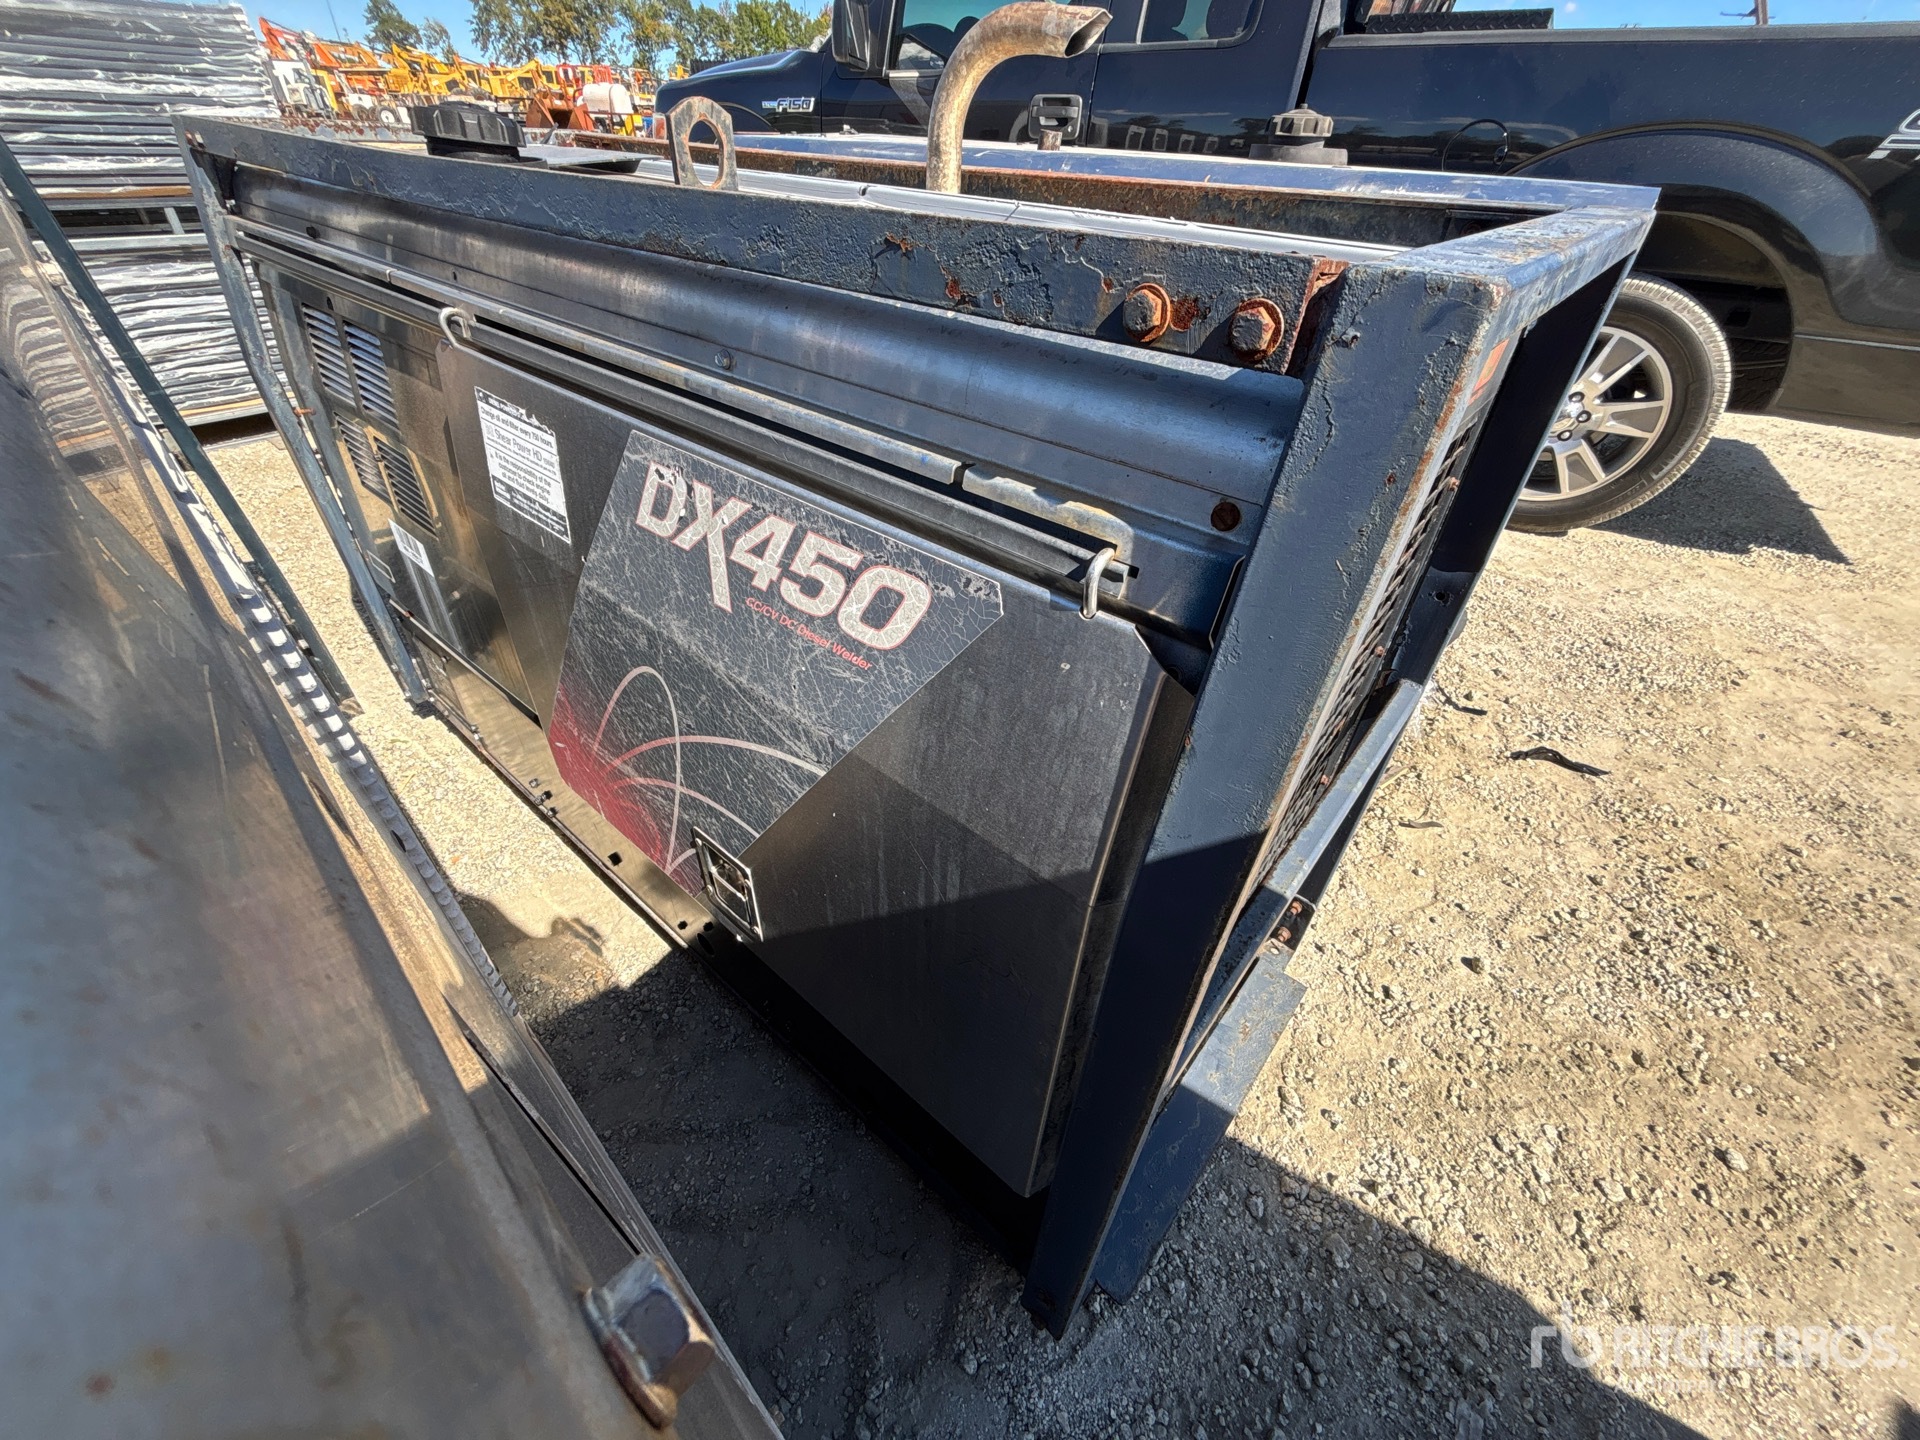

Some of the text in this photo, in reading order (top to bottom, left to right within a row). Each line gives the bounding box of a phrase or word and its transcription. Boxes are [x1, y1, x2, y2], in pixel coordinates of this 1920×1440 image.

[501, 417, 509, 427] and
[519, 427, 531, 439] every
[494, 428, 512, 446] Shear
[512, 437, 531, 457] Power
[532, 448, 542, 462] HD
[507, 475, 515, 484] and
[515, 478, 525, 489] fluid
[509, 460, 538, 482] responsibility
[522, 475, 535, 487] check
[635, 461, 934, 650] DX450
[745, 597, 873, 671] CC/CV DC Diesel Welder
